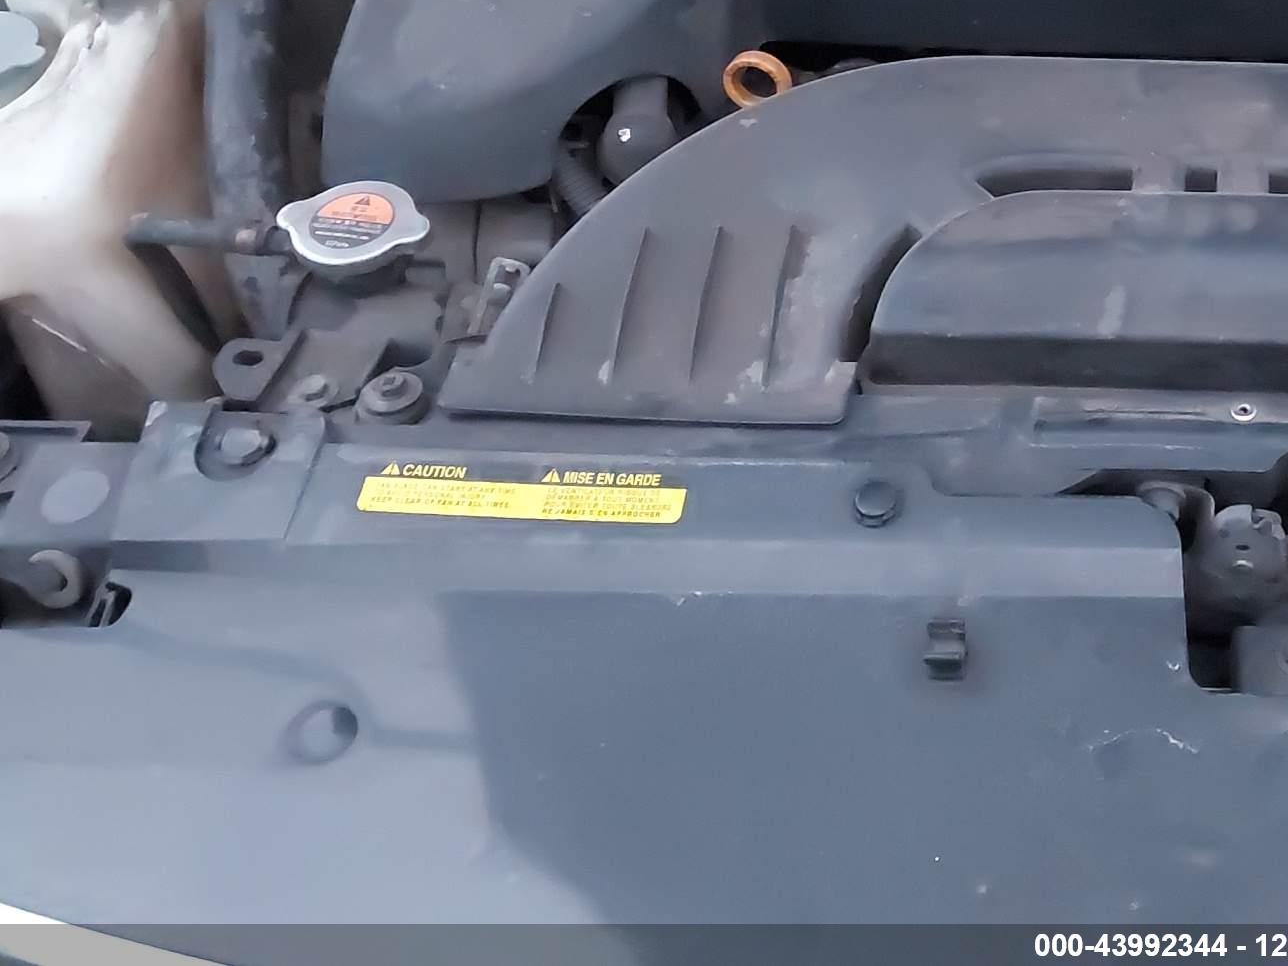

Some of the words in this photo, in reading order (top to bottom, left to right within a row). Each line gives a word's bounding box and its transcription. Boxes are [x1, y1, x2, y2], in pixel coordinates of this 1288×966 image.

[402, 463, 467, 479] CAUTION
[563, 471, 595, 484] MISE
[595, 472, 615, 485] EN
[616, 473, 662, 487] GARDE
